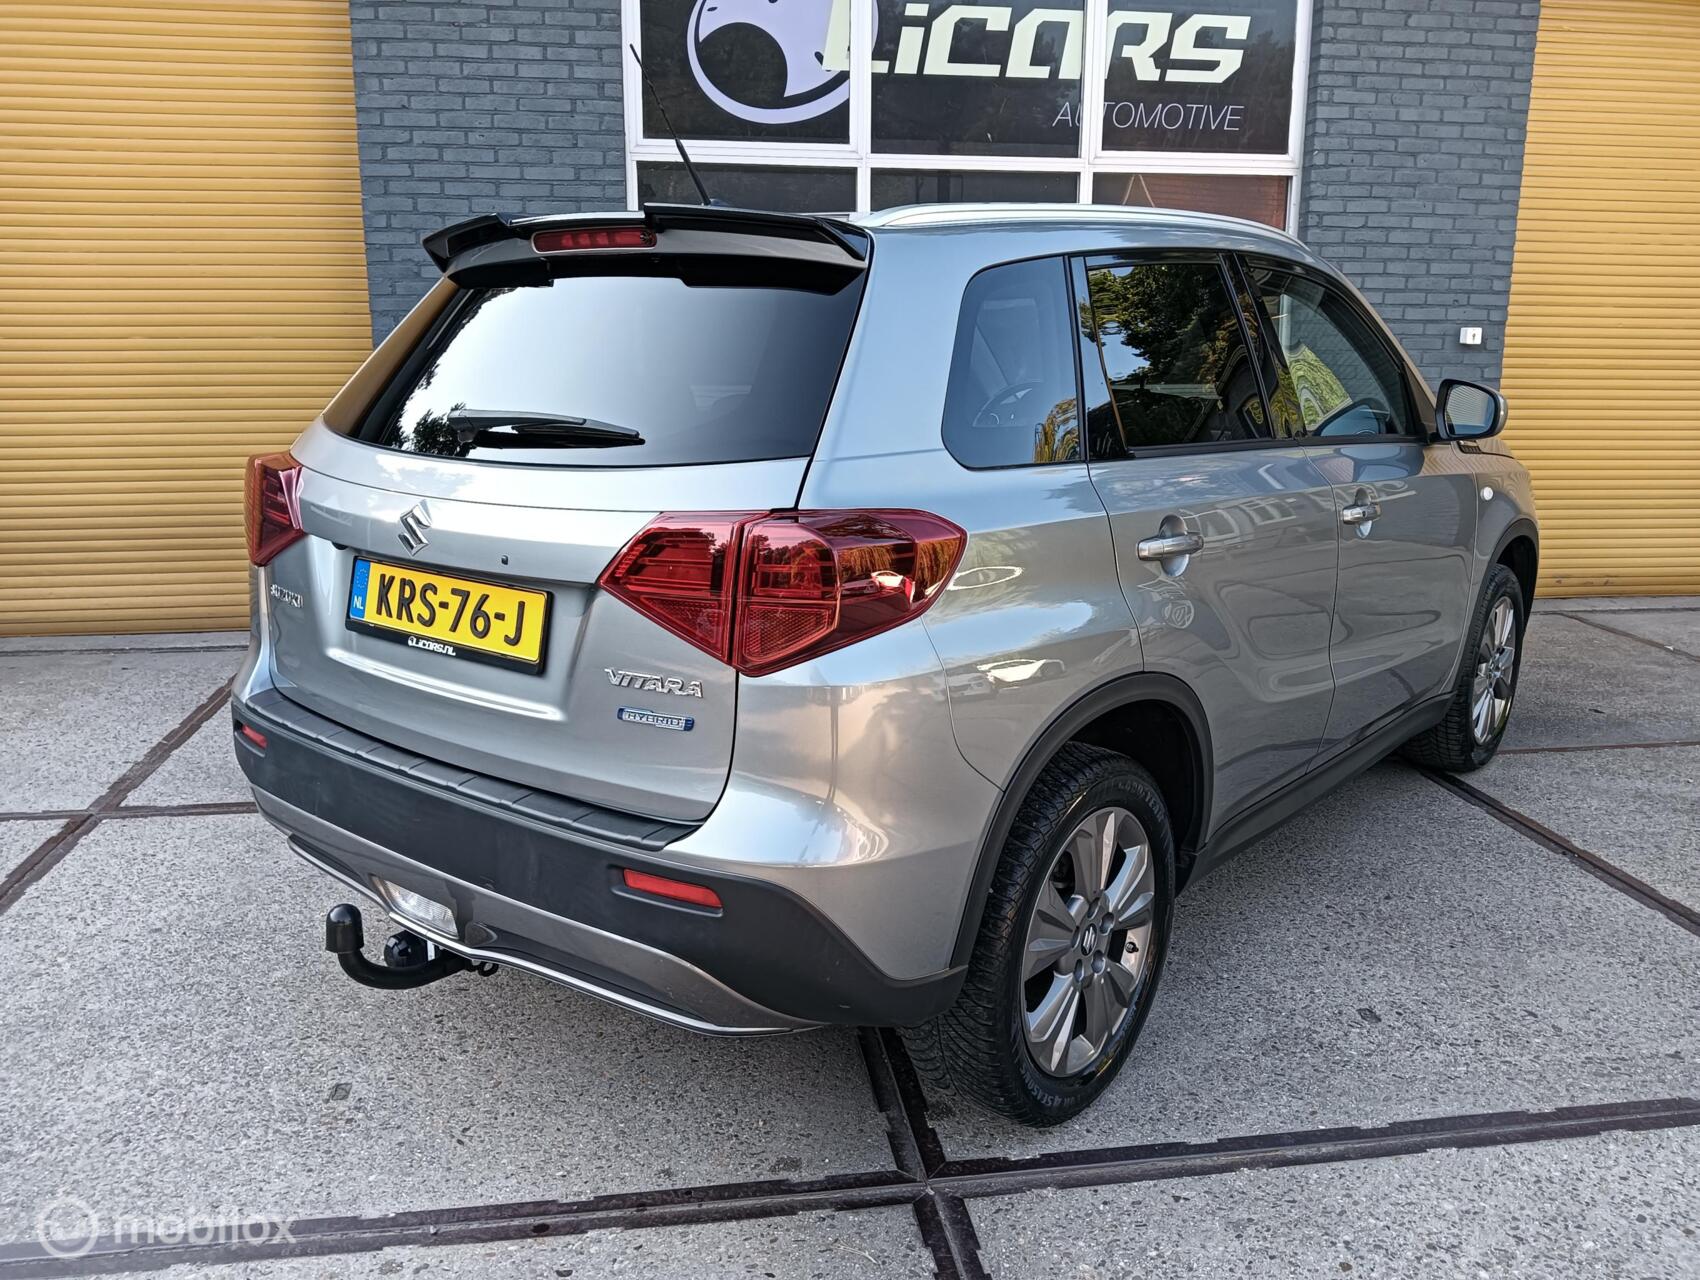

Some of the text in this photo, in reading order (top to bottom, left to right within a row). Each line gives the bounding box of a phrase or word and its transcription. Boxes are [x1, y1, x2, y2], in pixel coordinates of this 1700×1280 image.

[353, 595, 364, 611] NL
[376, 573, 526, 647] KRS-76-J
[604, 667, 704, 699] VITARA
[625, 712, 681, 727] HYBRID
